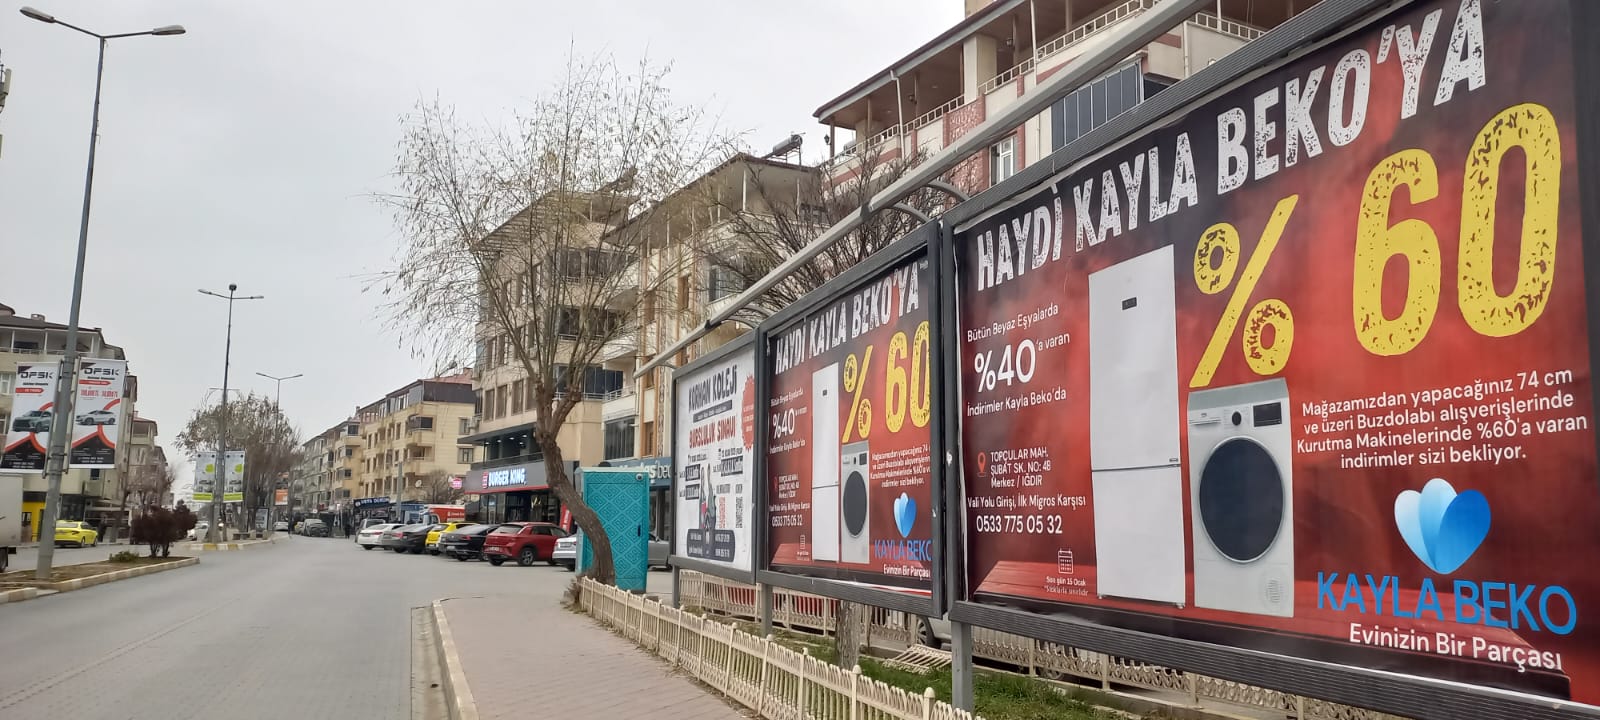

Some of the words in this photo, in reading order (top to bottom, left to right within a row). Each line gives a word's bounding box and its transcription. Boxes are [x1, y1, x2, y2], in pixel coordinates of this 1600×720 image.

[977, 185, 1062, 291] HAYDİ
[1074, 132, 1197, 252] KAYLA
[1217, 0, 1486, 195] BEKO'YA
[1353, 103, 1561, 357] 60
[808, 302, 847, 359] KAYLA
[851, 262, 919, 339] BEKO'YA
[967, 327, 992, 343] Bütün
[992, 320, 1016, 336] Beyaz
[1017, 302, 1059, 330] Eşyalarda
[1045, 333, 1070, 350] varan
[885, 320, 930, 433] 60
[1302, 392, 1406, 418] Mağazamızdan
[1410, 378, 1513, 407] yapacağınız
[1516, 371, 1539, 390] 74
[1543, 369, 1573, 386] cm
[1005, 395, 1029, 411] Kayla
[1030, 386, 1067, 405] Beko'da
[1303, 422, 1318, 435] ve
[1322, 417, 1354, 433] üzeri
[1357, 407, 1436, 428] Buzdolabı
[1439, 391, 1574, 425] alışverişlerinde
[1297, 436, 1352, 454] Kurutma
[1355, 425, 1472, 450] Makinelerinde
[1476, 417, 1531, 440] %60'a
[1536, 415, 1587, 434] varan
[990, 463, 1012, 478] ŞUBAT
[1014, 462, 1026, 473] SK.
[1028, 461, 1041, 472] NO:
[991, 449, 1028, 464] TOPÇULAR
[1031, 447, 1049, 458] MAH.
[1341, 451, 1415, 469] indirimler
[1418, 449, 1445, 465] sizi
[1450, 442, 1527, 466] bekliyor.
[488, 470, 509, 487] BURGER
[510, 468, 526, 484] KING
[991, 477, 1015, 488] Merkez
[1022, 473, 1042, 487] IĞDIR
[968, 496, 979, 508] Vali
[980, 496, 995, 507] Yolu
[996, 494, 1016, 511] Girişi,
[1029, 493, 1056, 510] Migros
[1057, 494, 1086, 510] Karşısı
[976, 515, 1001, 533] 0533
[1004, 515, 1023, 534] 775
[1027, 515, 1044, 534] 05
[1047, 515, 1063, 534] 32
[1317, 571, 1444, 622] KAYLA
[1453, 579, 1577, 635] BEKO
[1350, 622, 1429, 651] Evinizin
[1436, 632, 1466, 656] Bir
[1472, 636, 1562, 673] Parçası
